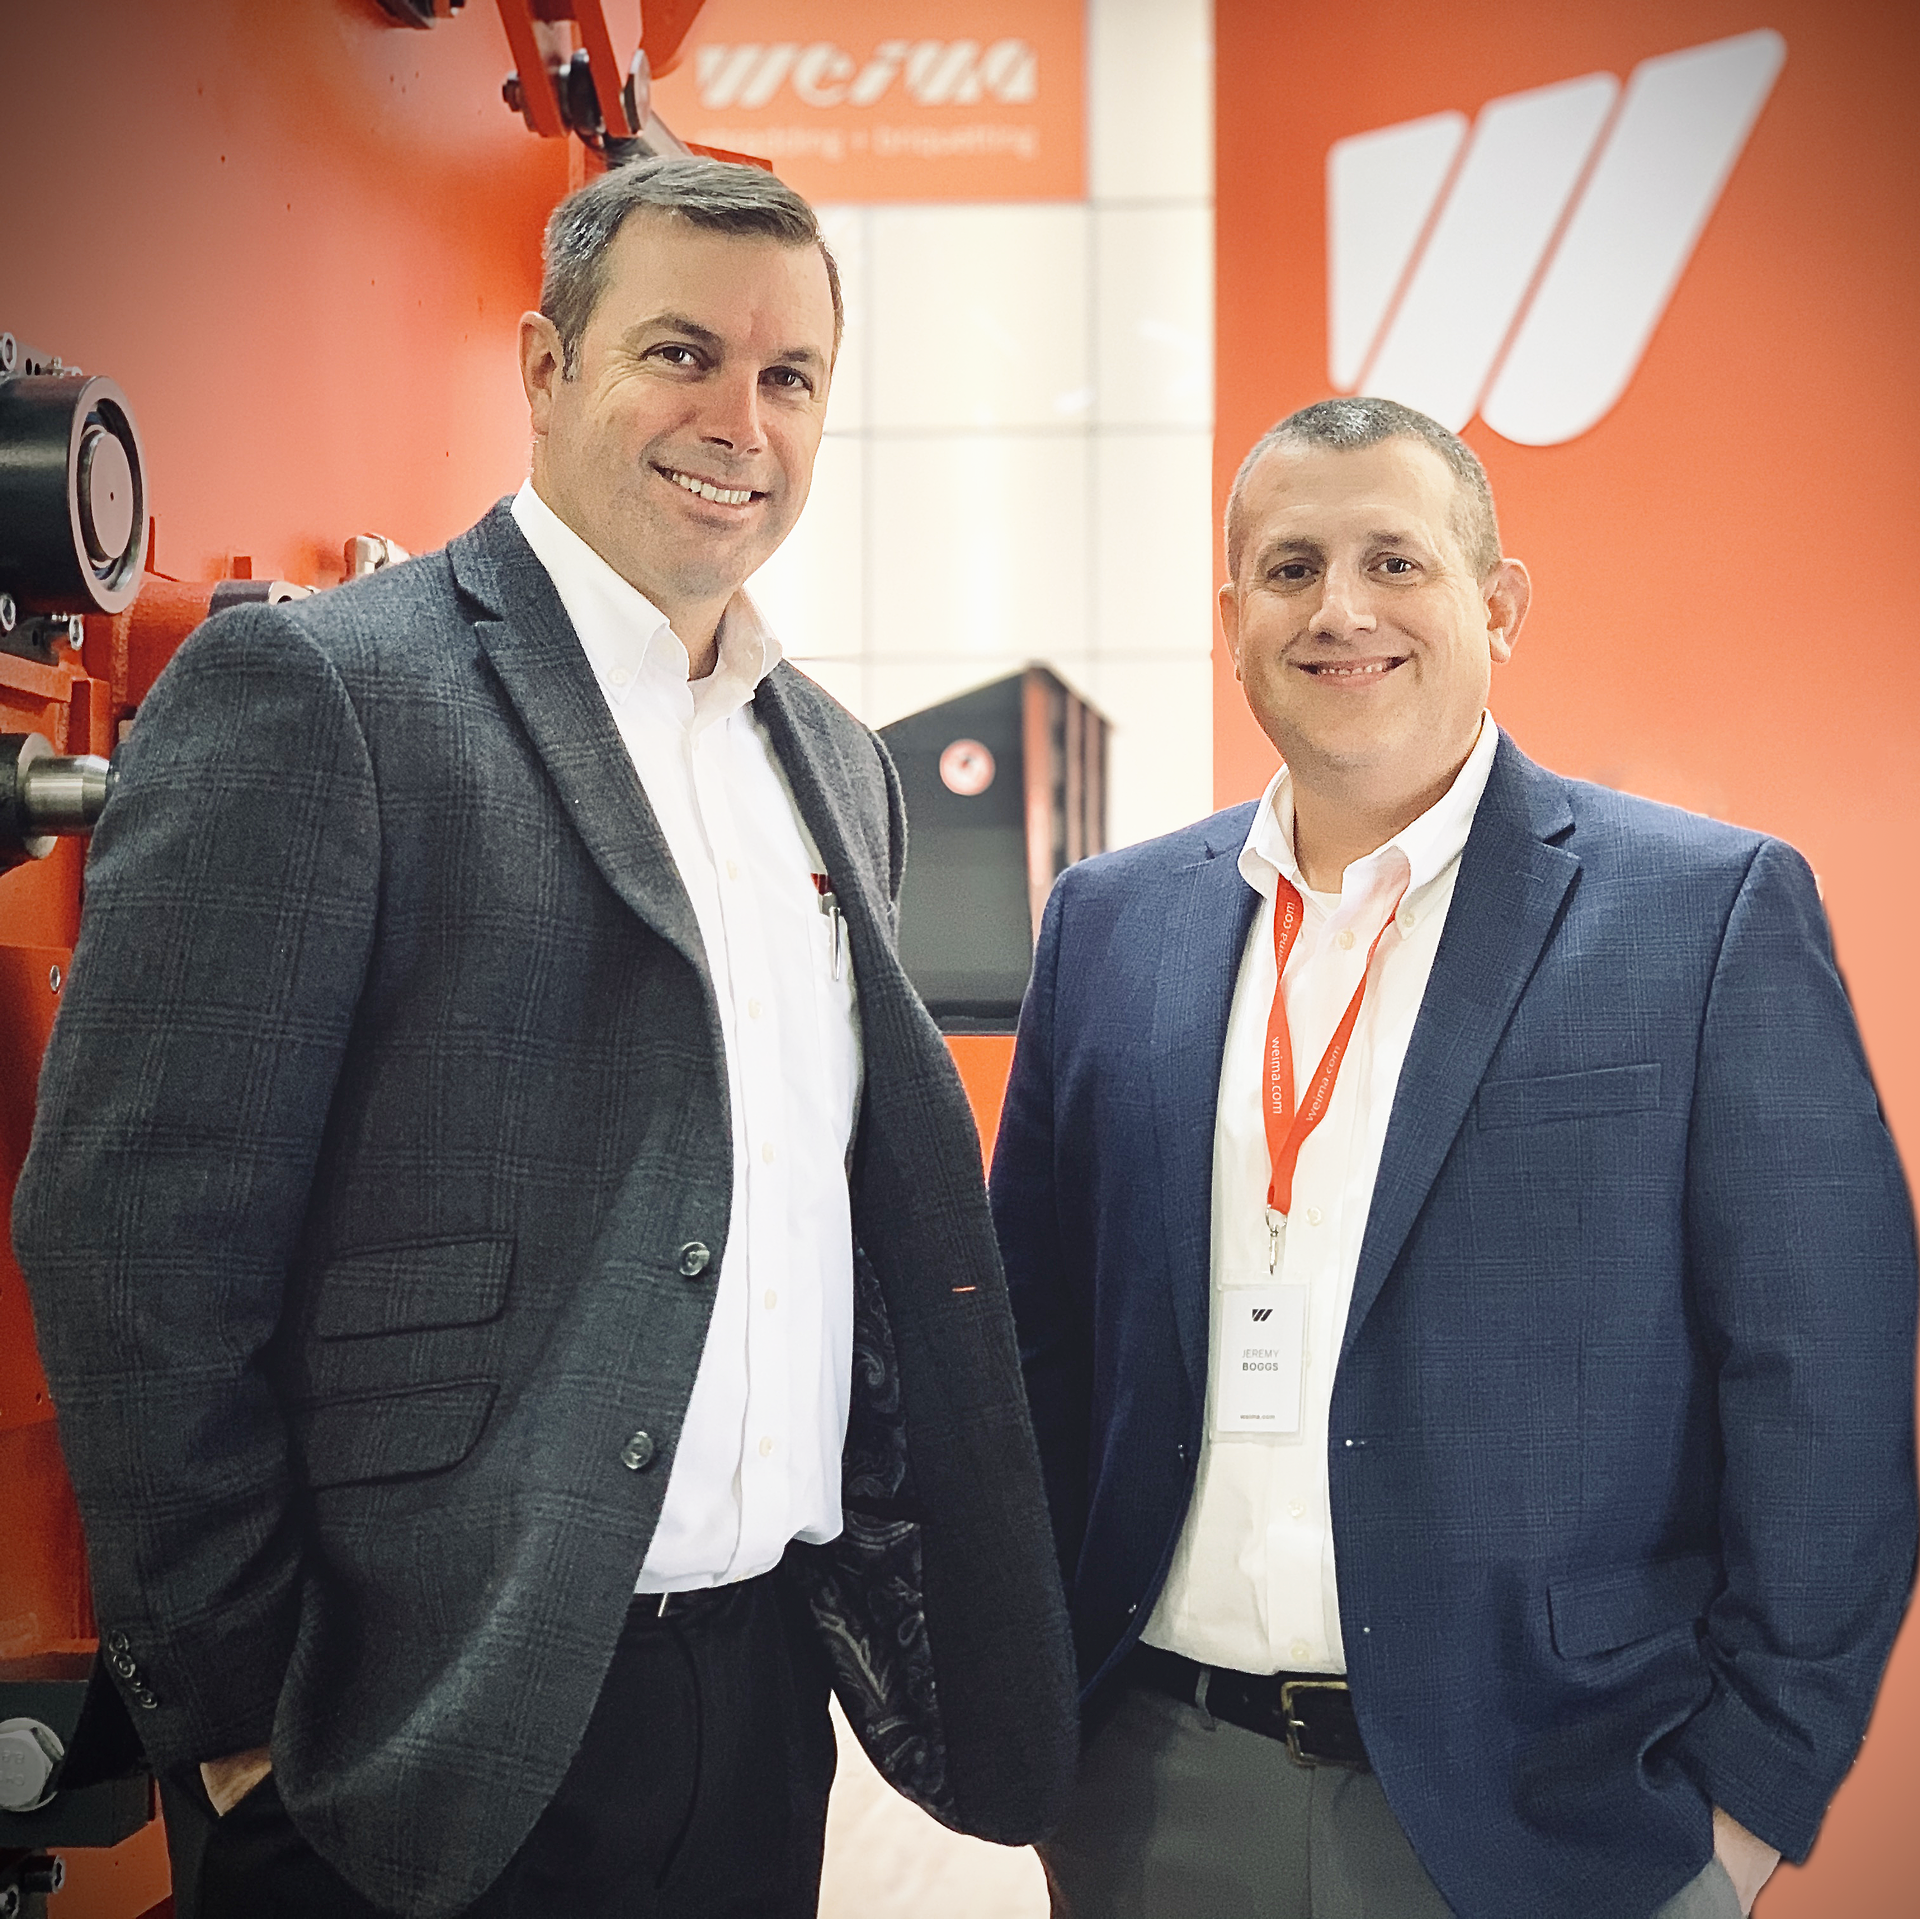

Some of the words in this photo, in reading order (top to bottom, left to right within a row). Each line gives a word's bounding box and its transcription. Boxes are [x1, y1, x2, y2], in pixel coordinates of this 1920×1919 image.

[1271, 1036, 1283, 1114] weima.com
[1305, 1045, 1341, 1121] weima.com
[1242, 1348, 1280, 1359] JEREMY
[1242, 1362, 1279, 1372] BOGGS
